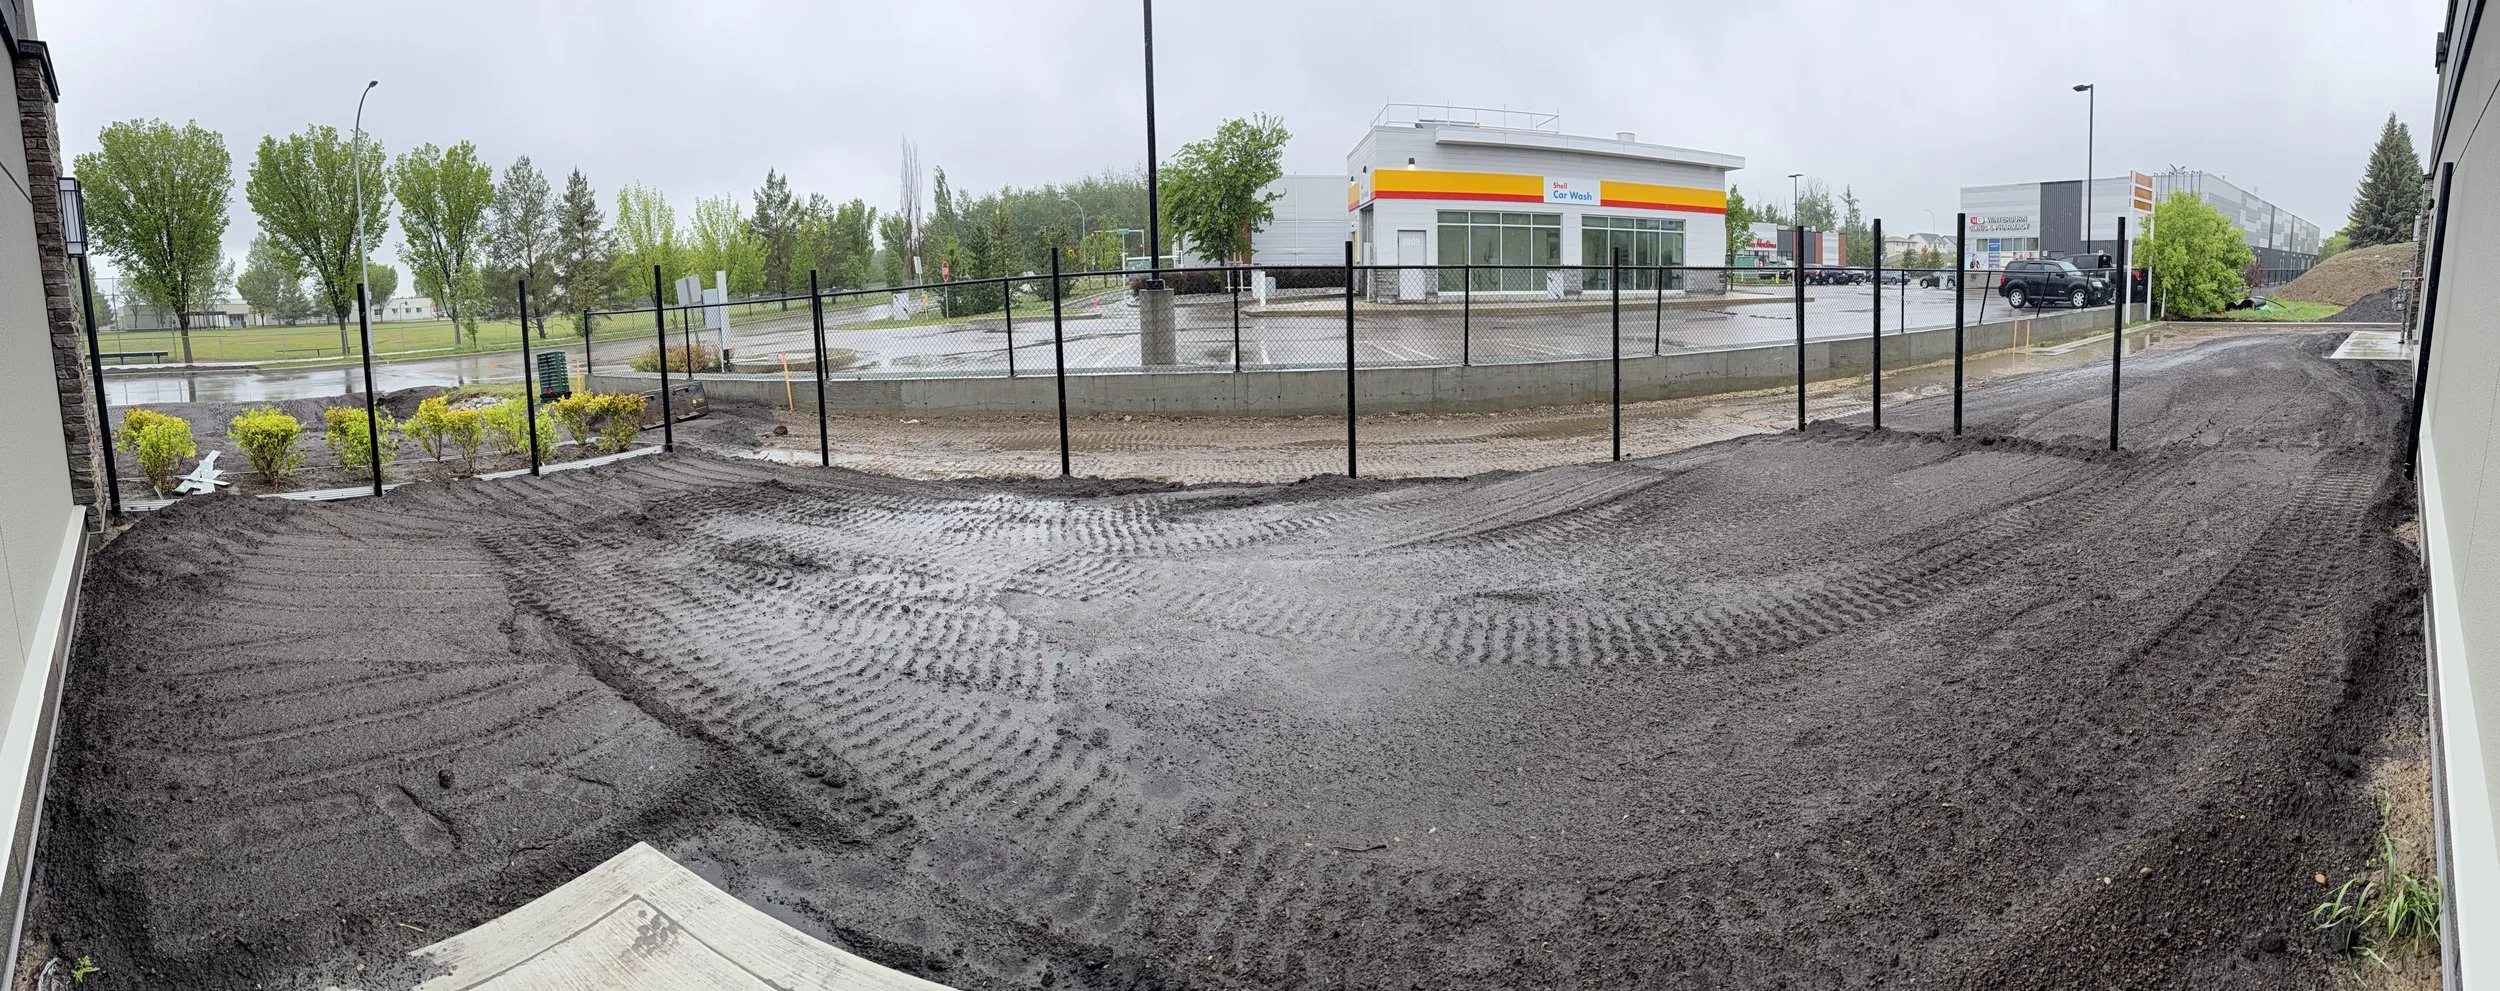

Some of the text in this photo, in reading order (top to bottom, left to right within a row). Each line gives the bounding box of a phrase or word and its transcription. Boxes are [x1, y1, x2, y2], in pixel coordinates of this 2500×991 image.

[1553, 190, 1593, 200] Car Wash
[1995, 223, 2030, 231] PHARMACY
